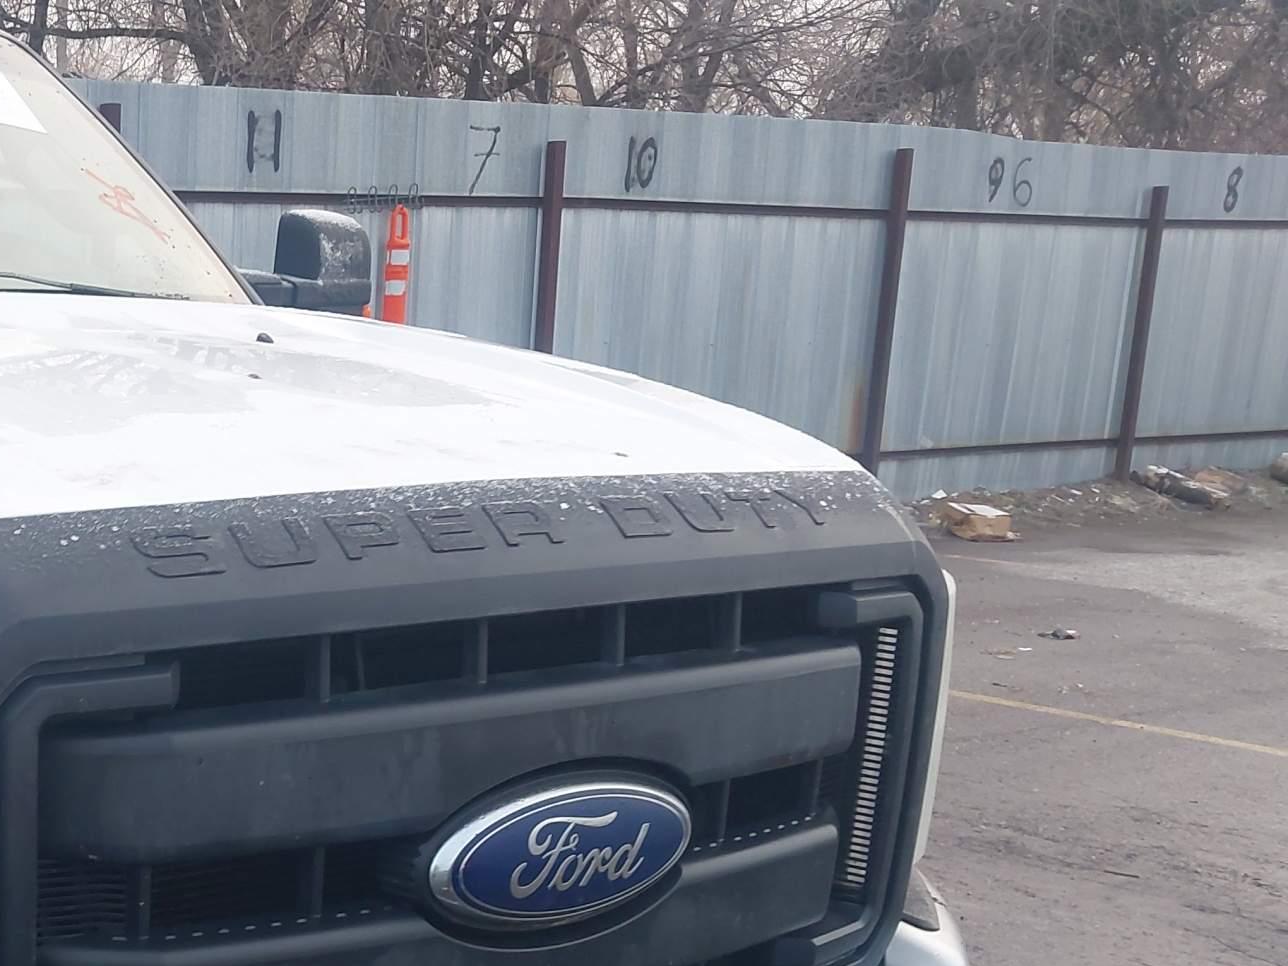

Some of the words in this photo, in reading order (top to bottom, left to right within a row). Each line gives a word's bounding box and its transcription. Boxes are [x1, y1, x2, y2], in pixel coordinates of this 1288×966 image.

[469, 125, 501, 196] 7
[624, 135, 658, 193] 10
[1222, 165, 1244, 214] 8
[128, 500, 566, 578] SUPER
[598, 486, 834, 539] DUTY
[510, 811, 650, 898] Ford
